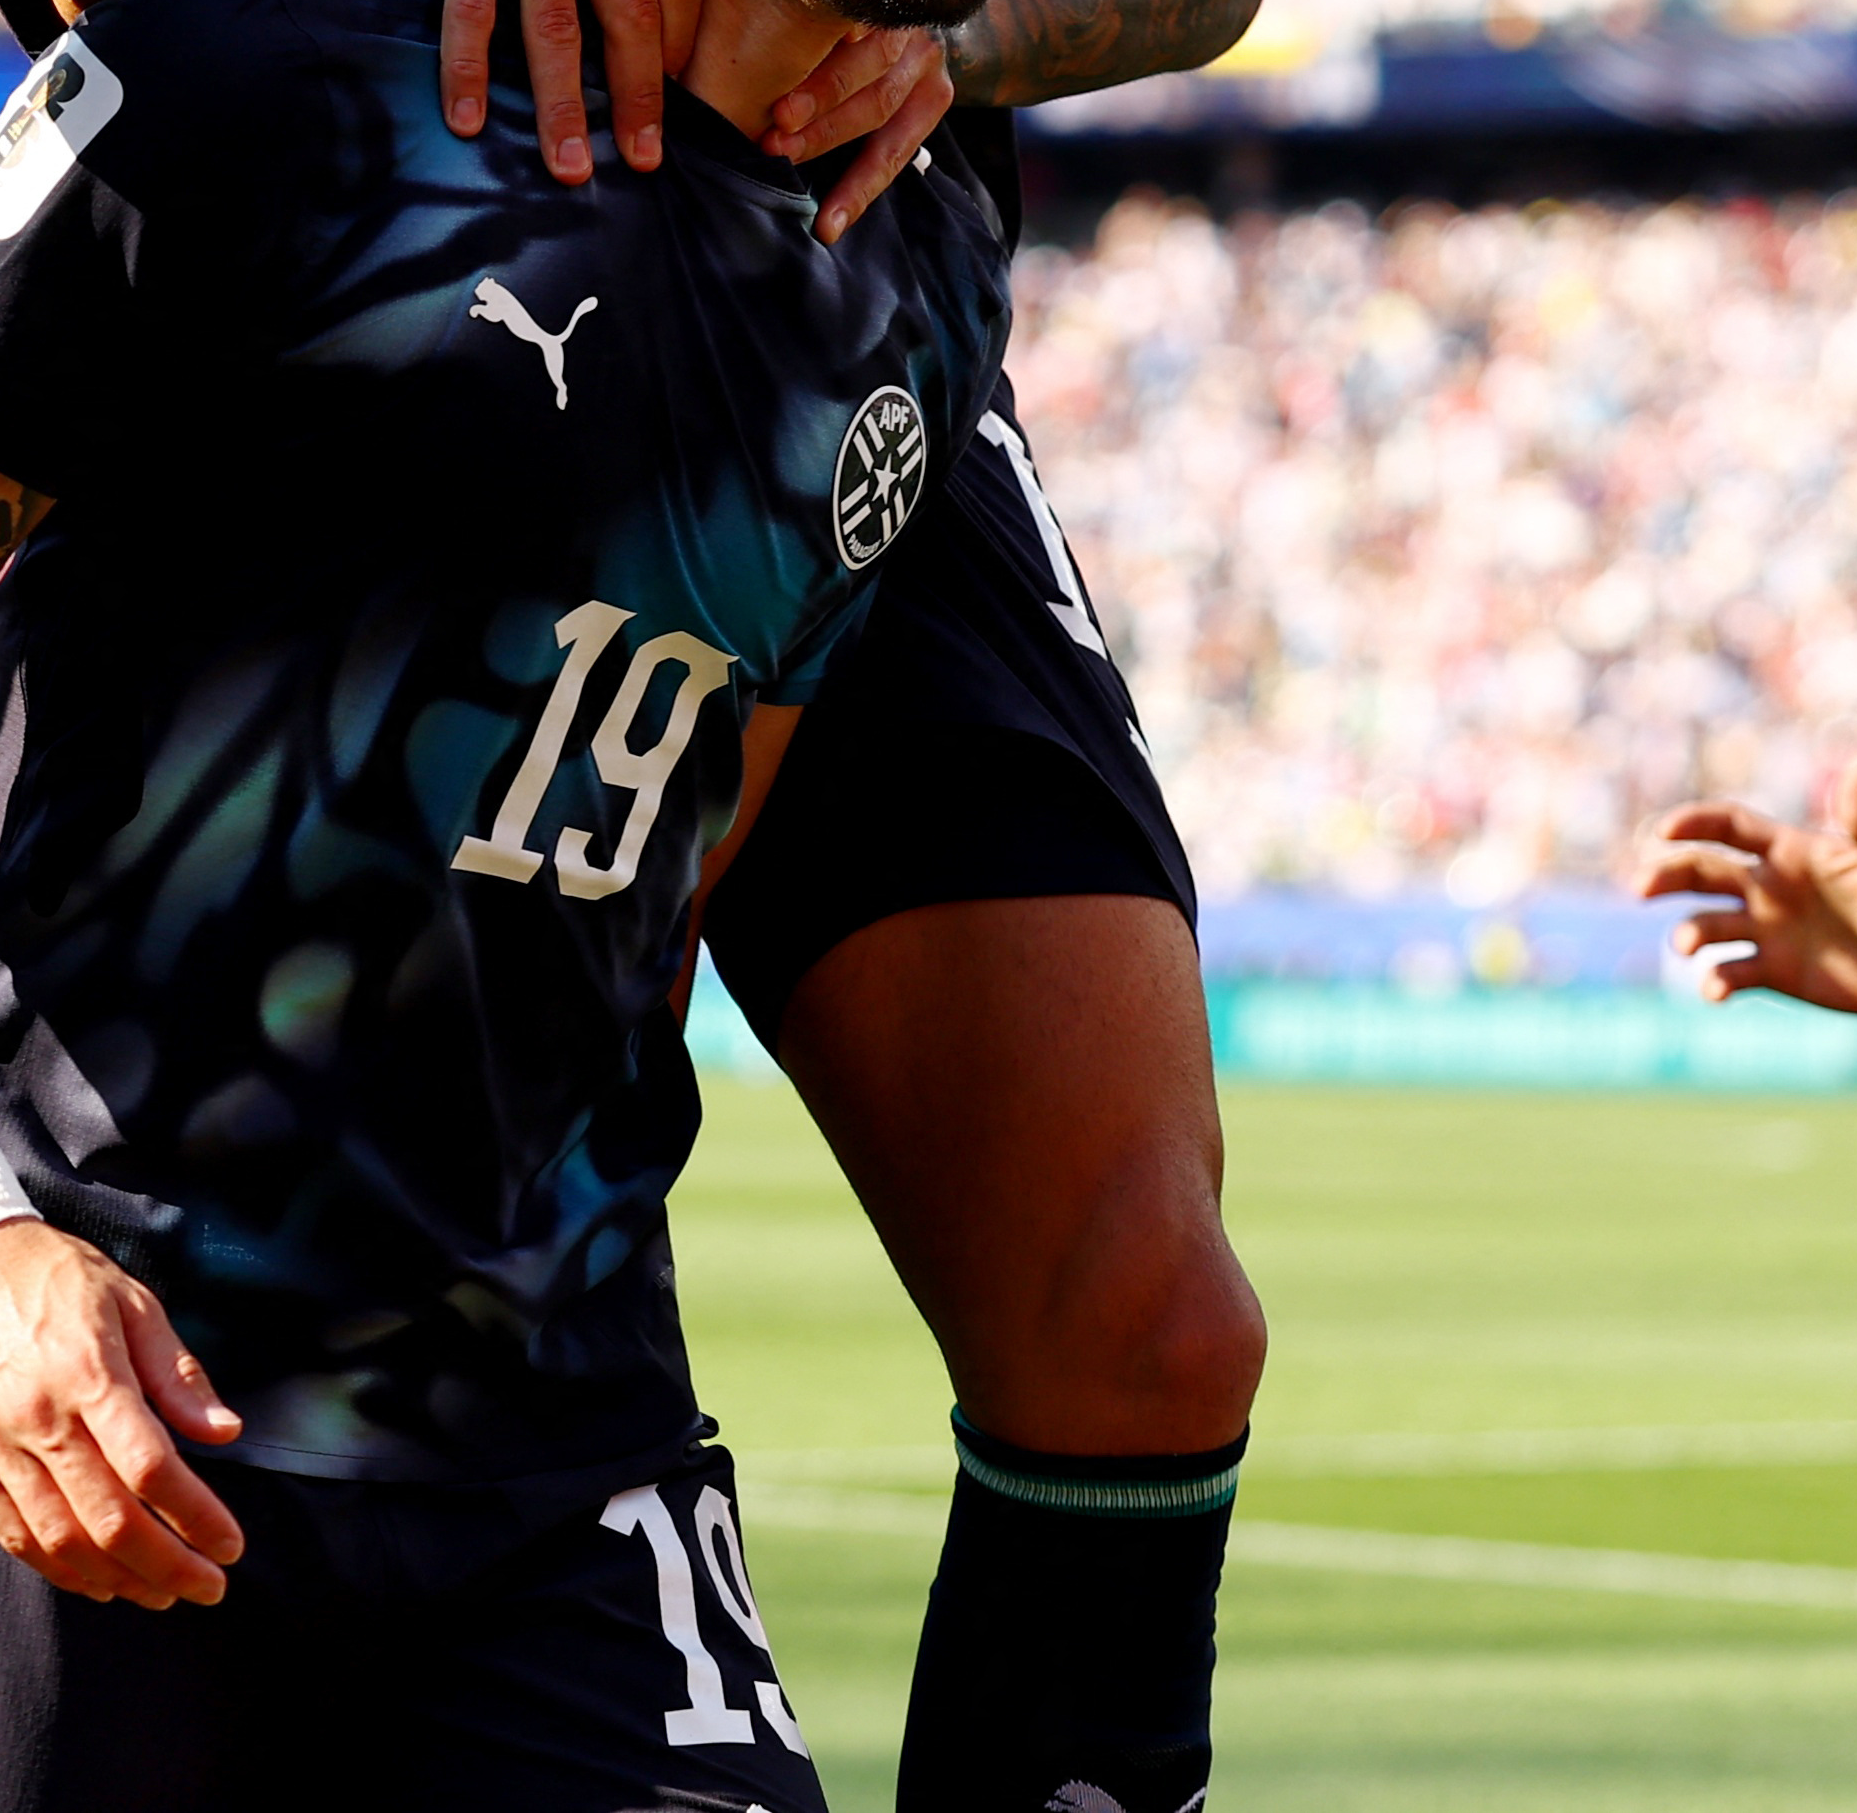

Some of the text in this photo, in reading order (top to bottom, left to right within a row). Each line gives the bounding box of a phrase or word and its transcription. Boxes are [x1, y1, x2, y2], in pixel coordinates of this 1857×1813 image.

[879, 401, 910, 434] APF
[847, 533, 883, 560] PARAGUAY
[451, 599, 741, 901] 19
[598, 1483, 810, 1761] 19
